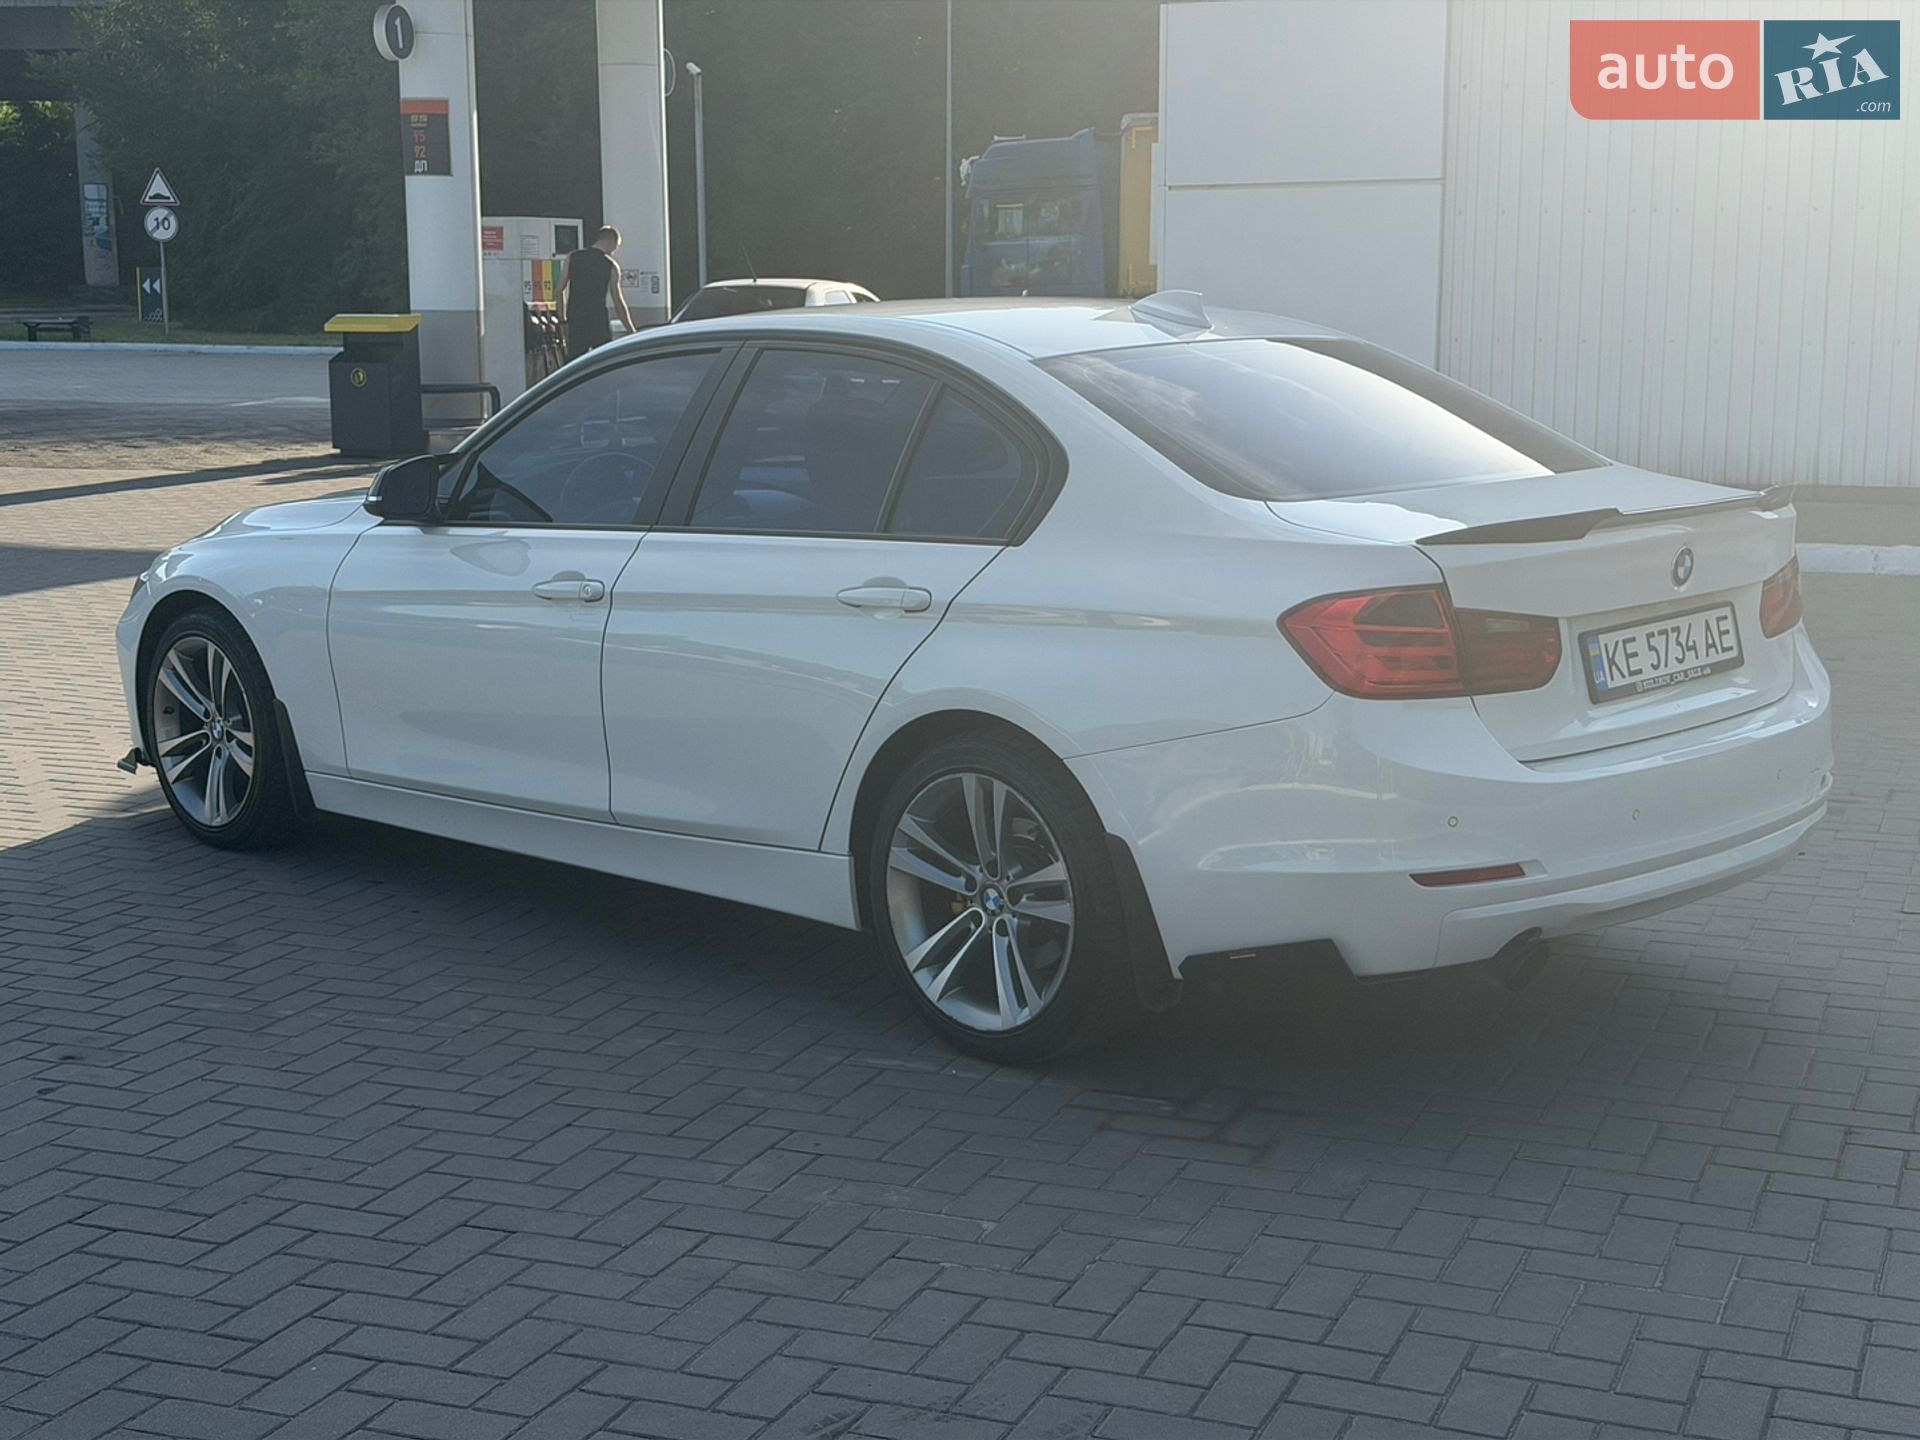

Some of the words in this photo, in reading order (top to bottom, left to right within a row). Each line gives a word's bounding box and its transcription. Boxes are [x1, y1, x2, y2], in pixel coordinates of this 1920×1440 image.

[394, 16, 404, 49] 1
[153, 217, 171, 231] 10
[1603, 636, 1643, 682] KE
[1646, 622, 1699, 671] 5734
[1704, 615, 1734, 658] AE
